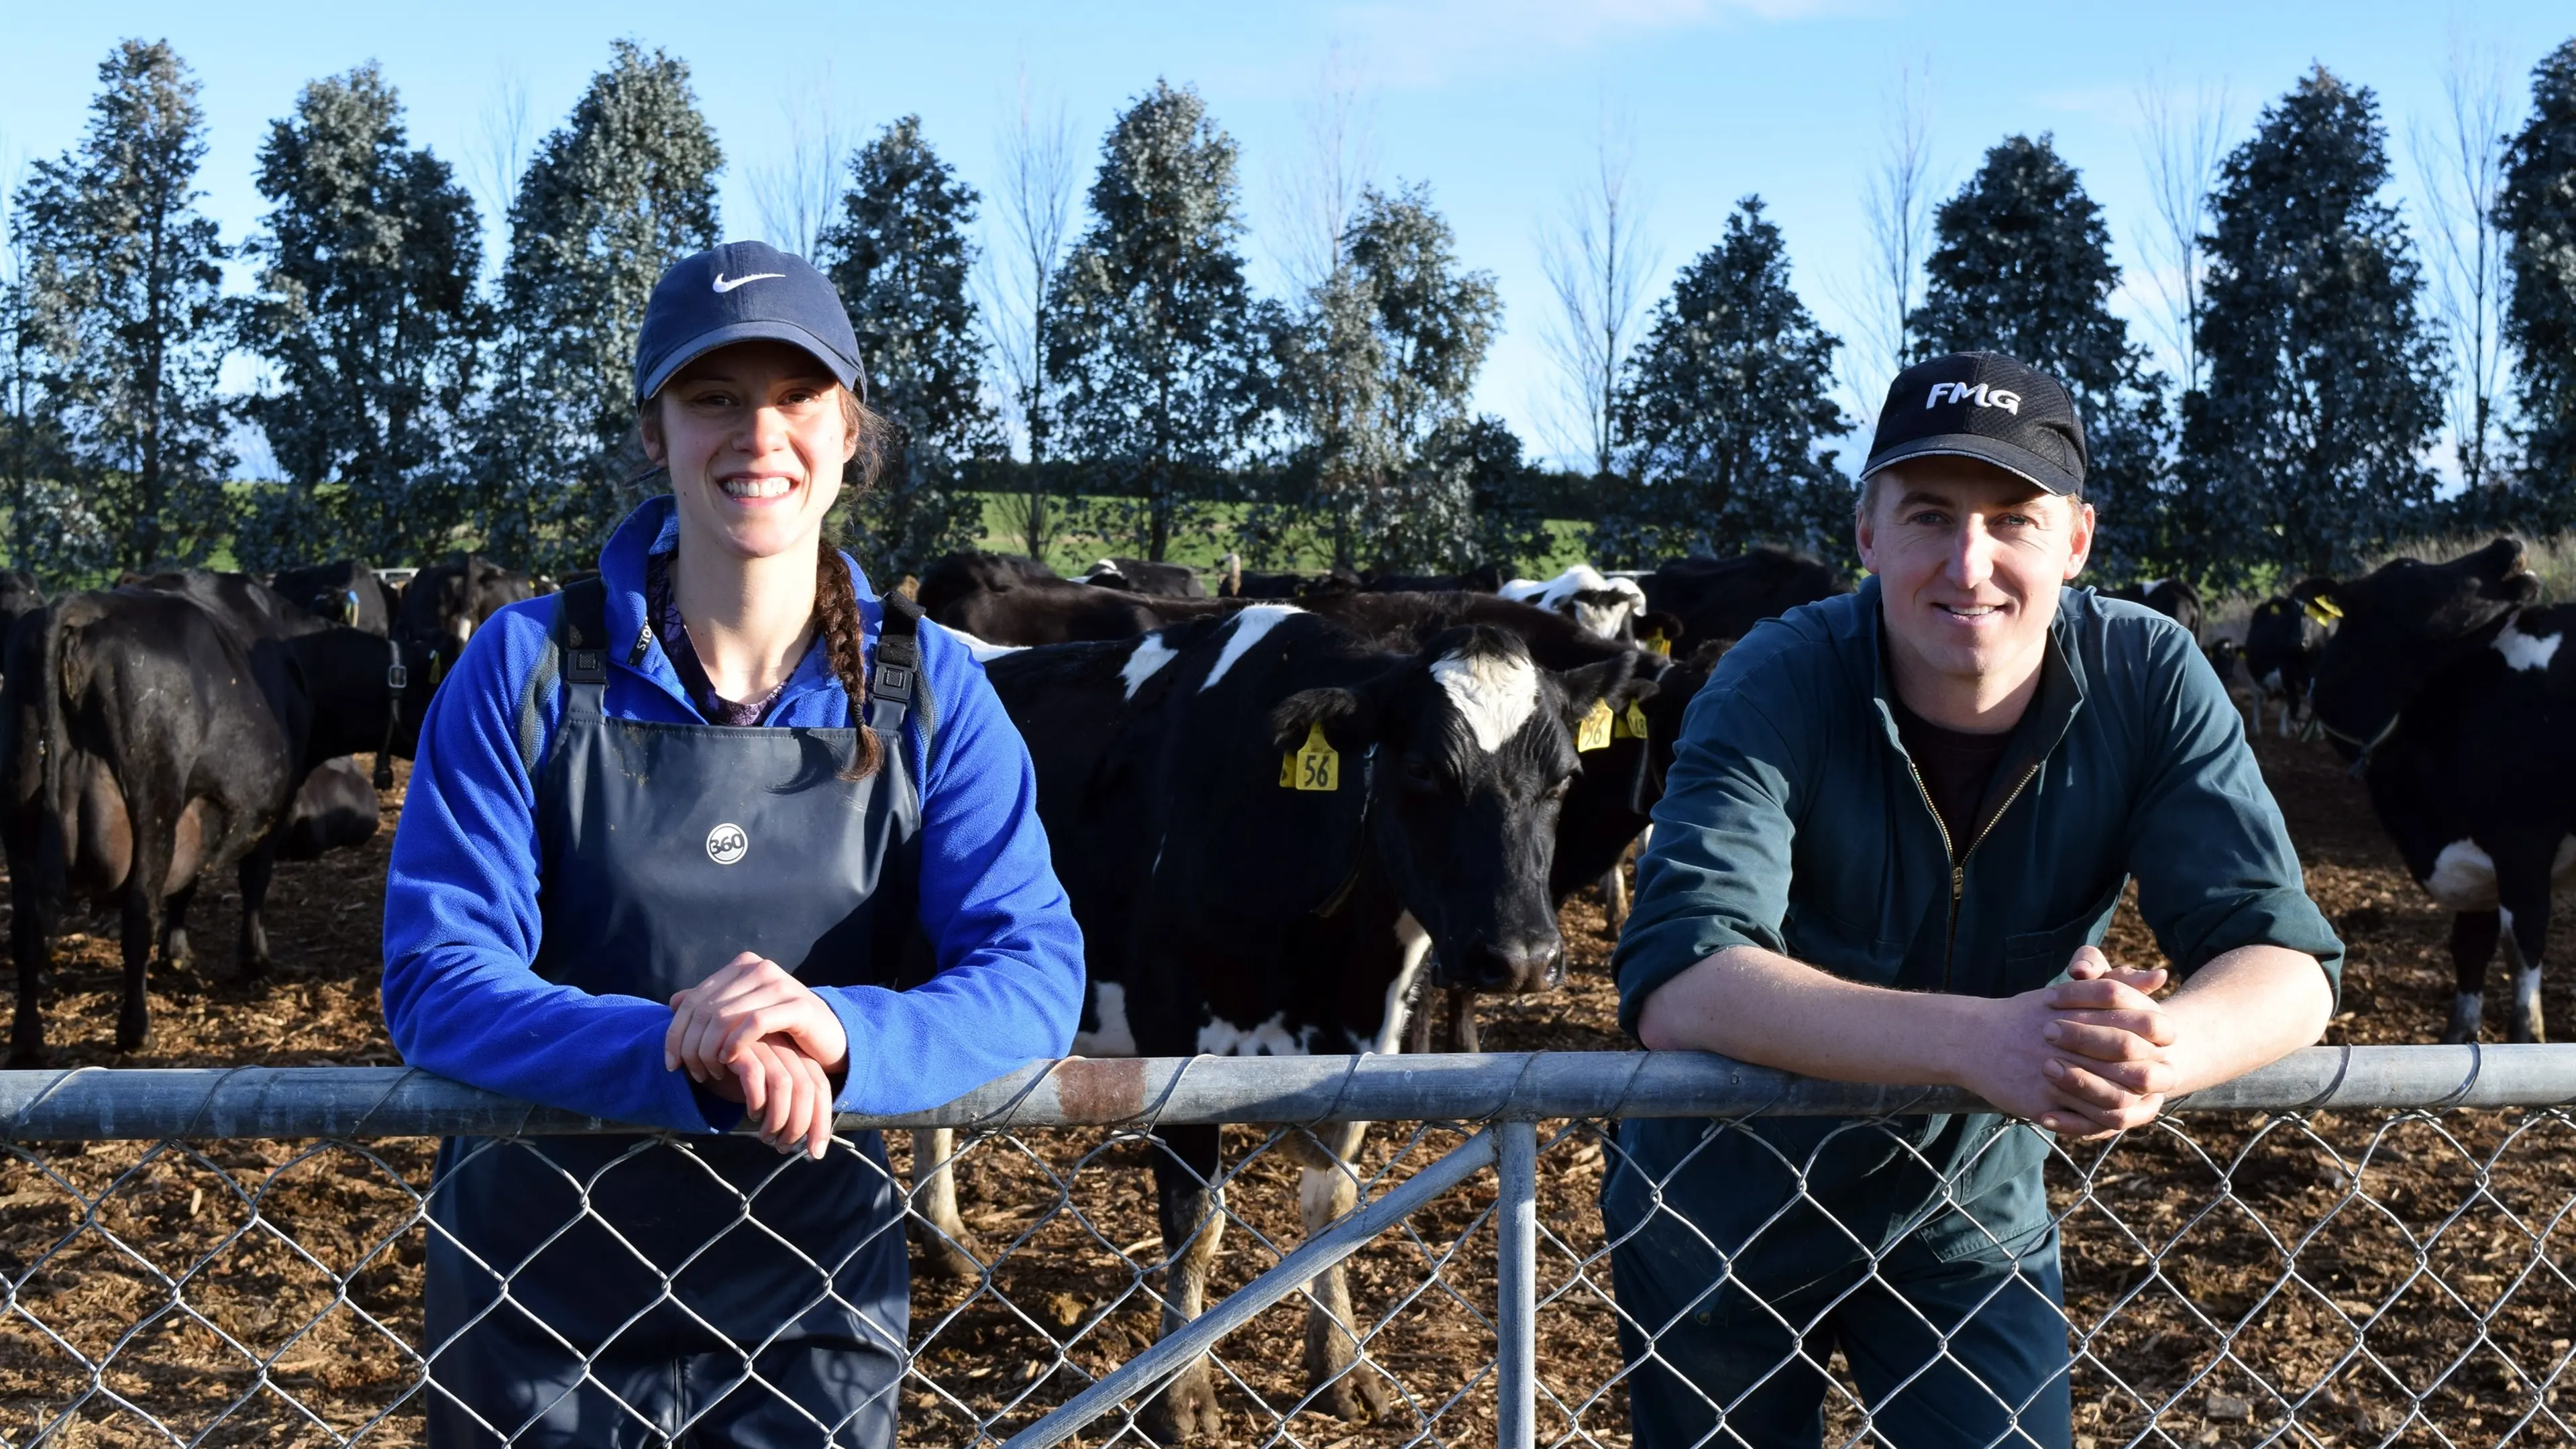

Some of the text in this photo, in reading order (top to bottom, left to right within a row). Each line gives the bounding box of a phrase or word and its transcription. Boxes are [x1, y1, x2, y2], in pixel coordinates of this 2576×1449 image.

[1926, 382, 2021, 415] FMG
[1304, 755, 1330, 787] 56
[710, 833, 745, 855] 360
